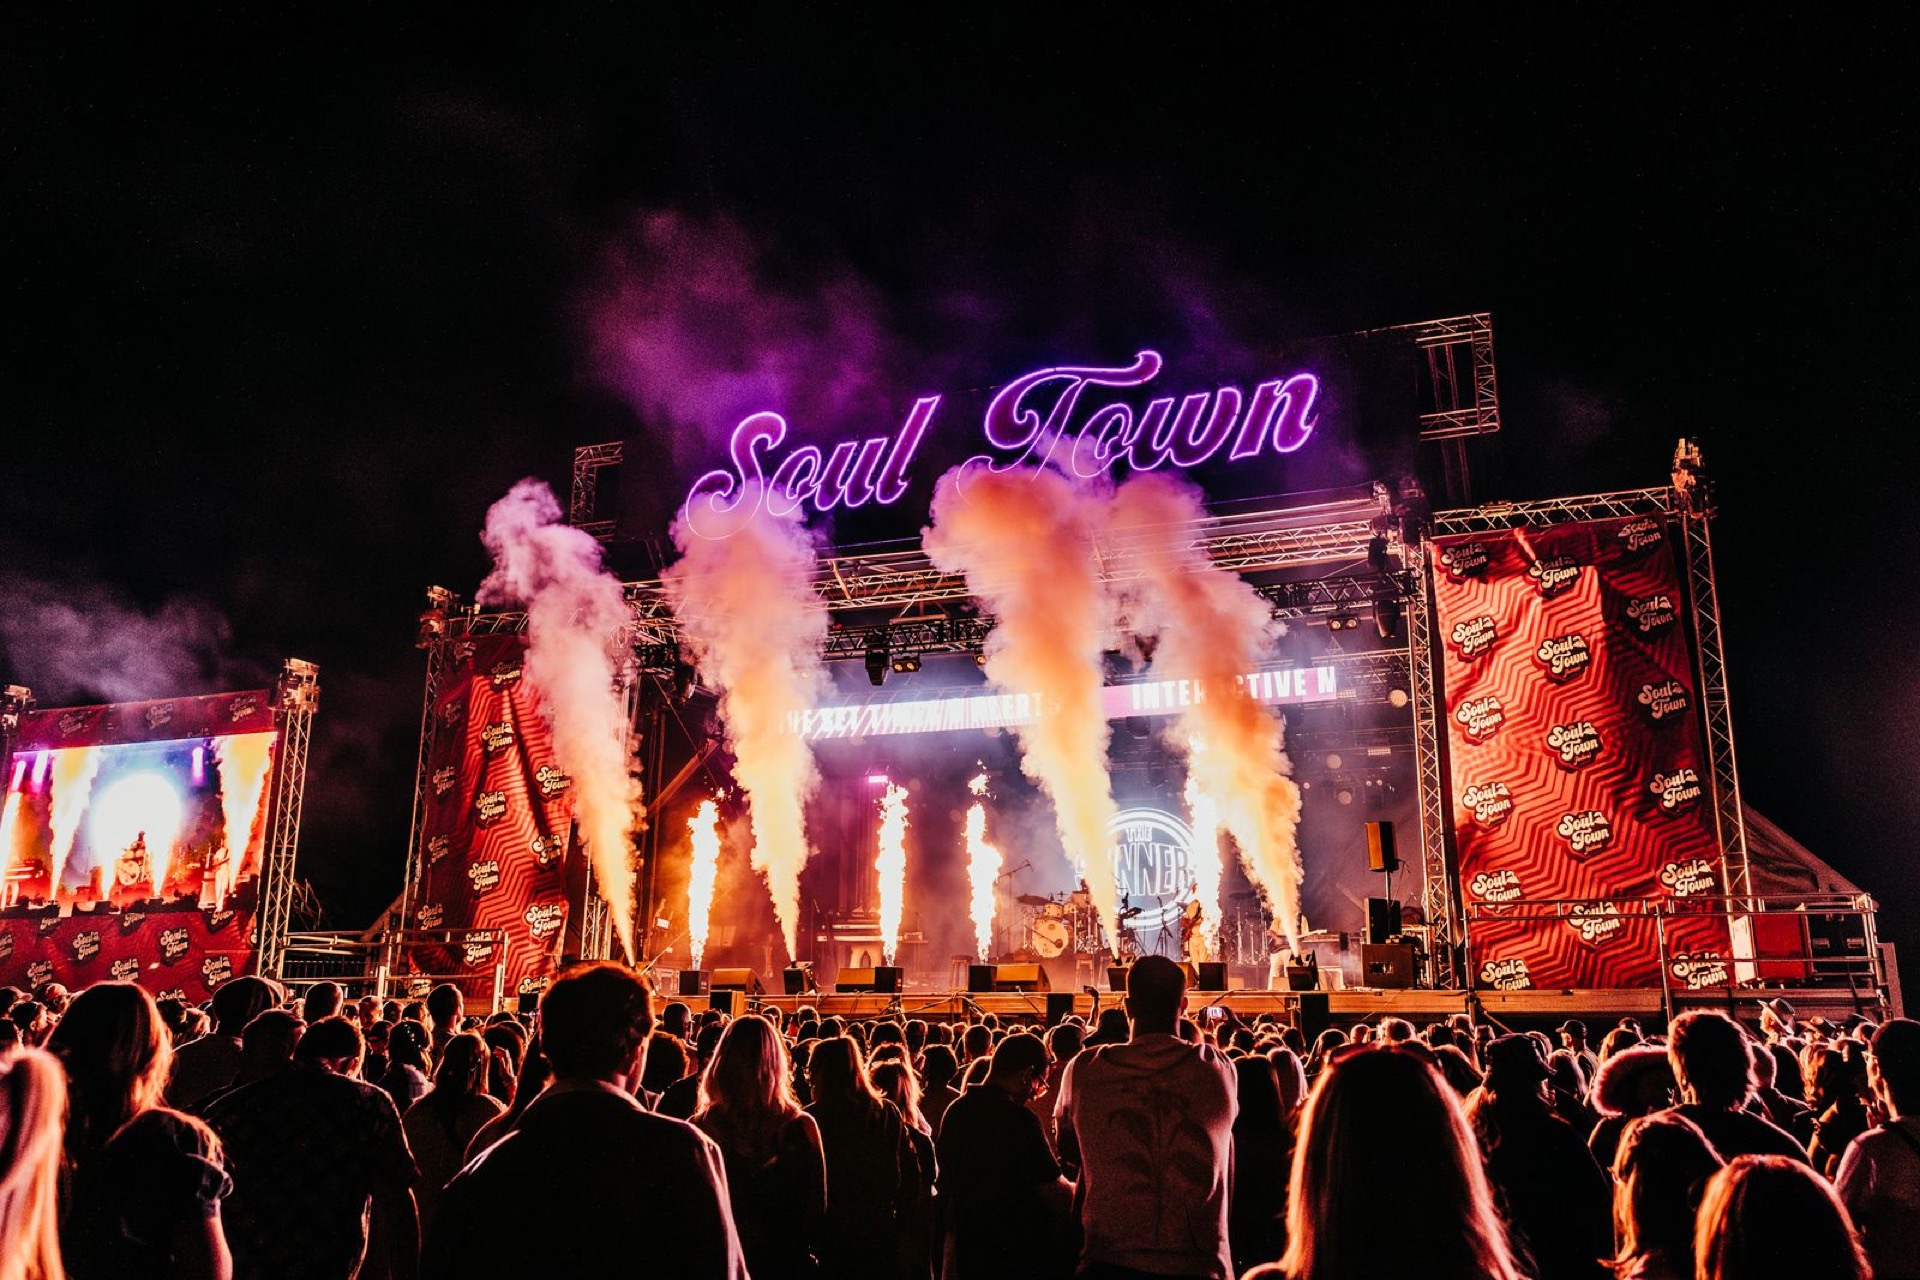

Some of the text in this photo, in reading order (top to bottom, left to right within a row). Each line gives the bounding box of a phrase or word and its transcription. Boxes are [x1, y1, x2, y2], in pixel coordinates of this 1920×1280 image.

[687, 350, 1318, 538] Soul Town
[1627, 531, 1661, 551] Town
[1441, 543, 1474, 564] Soul
[1452, 555, 1487, 575] Town
[1542, 566, 1578, 590] Town
[1626, 597, 1659, 619] Soul
[1452, 618, 1485, 641] Soul
[1639, 611, 1674, 632] Town
[1463, 629, 1495, 654] Town
[1538, 636, 1573, 660] Soul
[1552, 651, 1588, 674] Town
[1133, 669, 1306, 710] INTERCTIVE
[1638, 680, 1672, 704] Soul
[1457, 697, 1490, 721] Soul
[1651, 697, 1686, 719] Town
[1468, 712, 1502, 737] Town
[1547, 722, 1581, 747] Soul
[1561, 735, 1599, 762] Town
[1650, 770, 1686, 794] Soul
[1463, 783, 1495, 807] Soul
[1663, 786, 1700, 808] Town
[1475, 799, 1511, 823] Town
[1557, 811, 1593, 836] Soul
[1571, 826, 1609, 851] Town
[1471, 870, 1506, 895] Soul
[1661, 861, 1699, 886] Soul
[1485, 887, 1522, 909] Town
[1675, 875, 1714, 897] Town
[526, 905, 553, 922] Soul
[1569, 902, 1603, 926] Soul
[532, 918, 560, 936] Town
[1583, 918, 1620, 939] Town
[1480, 960, 1515, 982] Soul
[1688, 968, 1727, 989] Town
